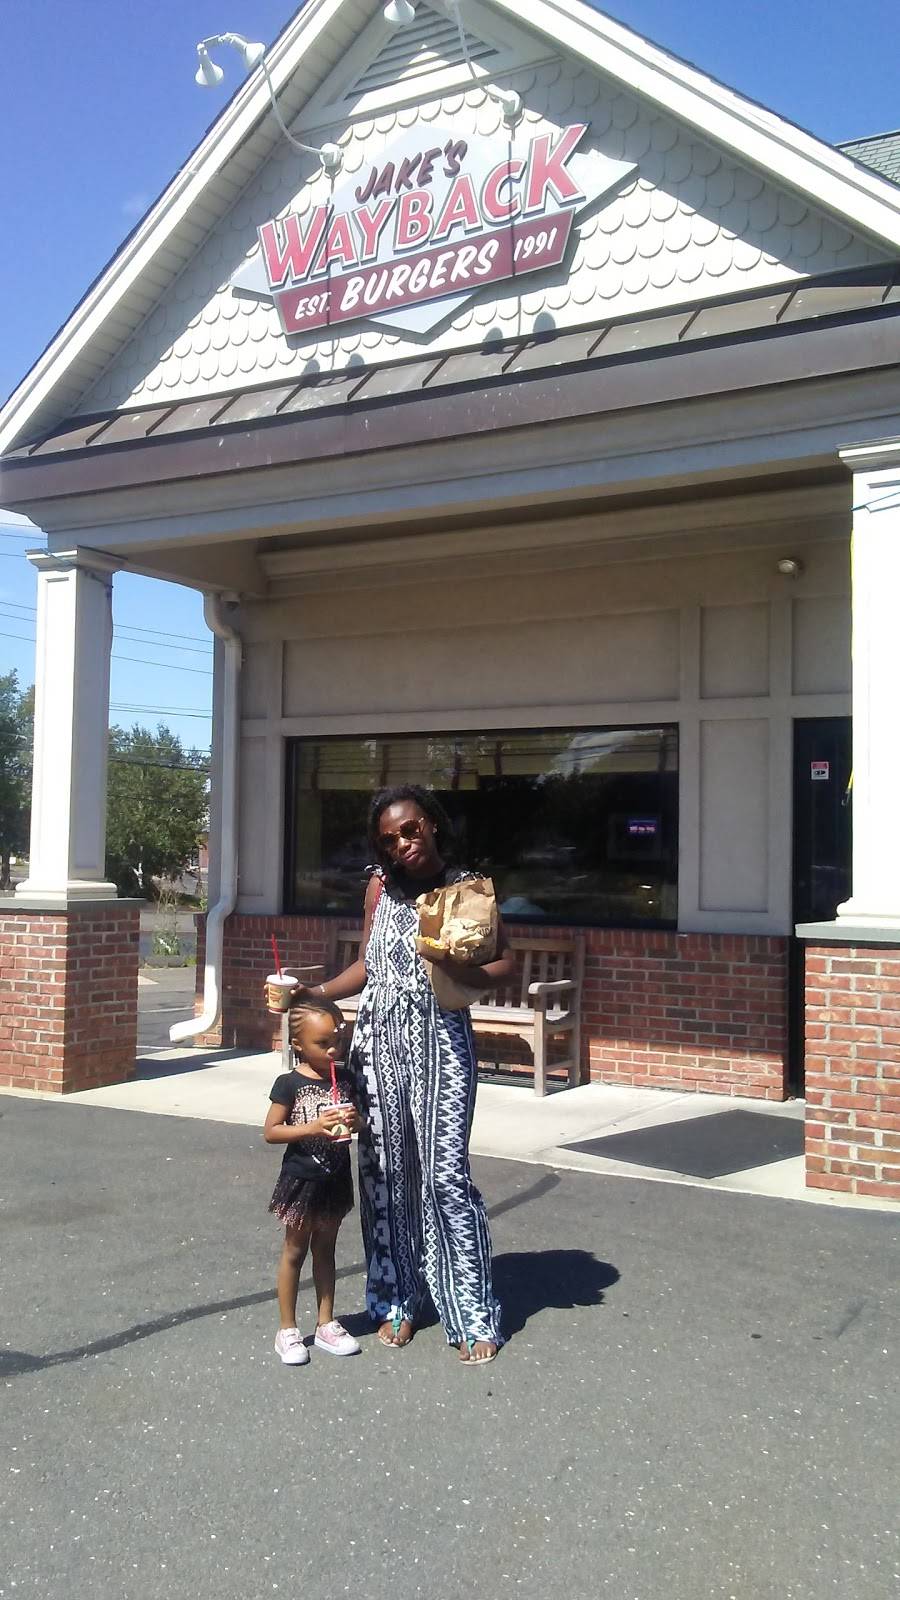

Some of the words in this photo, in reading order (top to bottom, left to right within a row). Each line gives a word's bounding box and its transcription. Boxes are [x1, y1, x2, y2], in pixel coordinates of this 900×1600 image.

[257, 122, 592, 288] WAYBACK
[355, 138, 467, 204] JAKE'S
[294, 291, 331, 320] EST.
[339, 238, 499, 313] BURGERS
[514, 227, 558, 262] 1991
